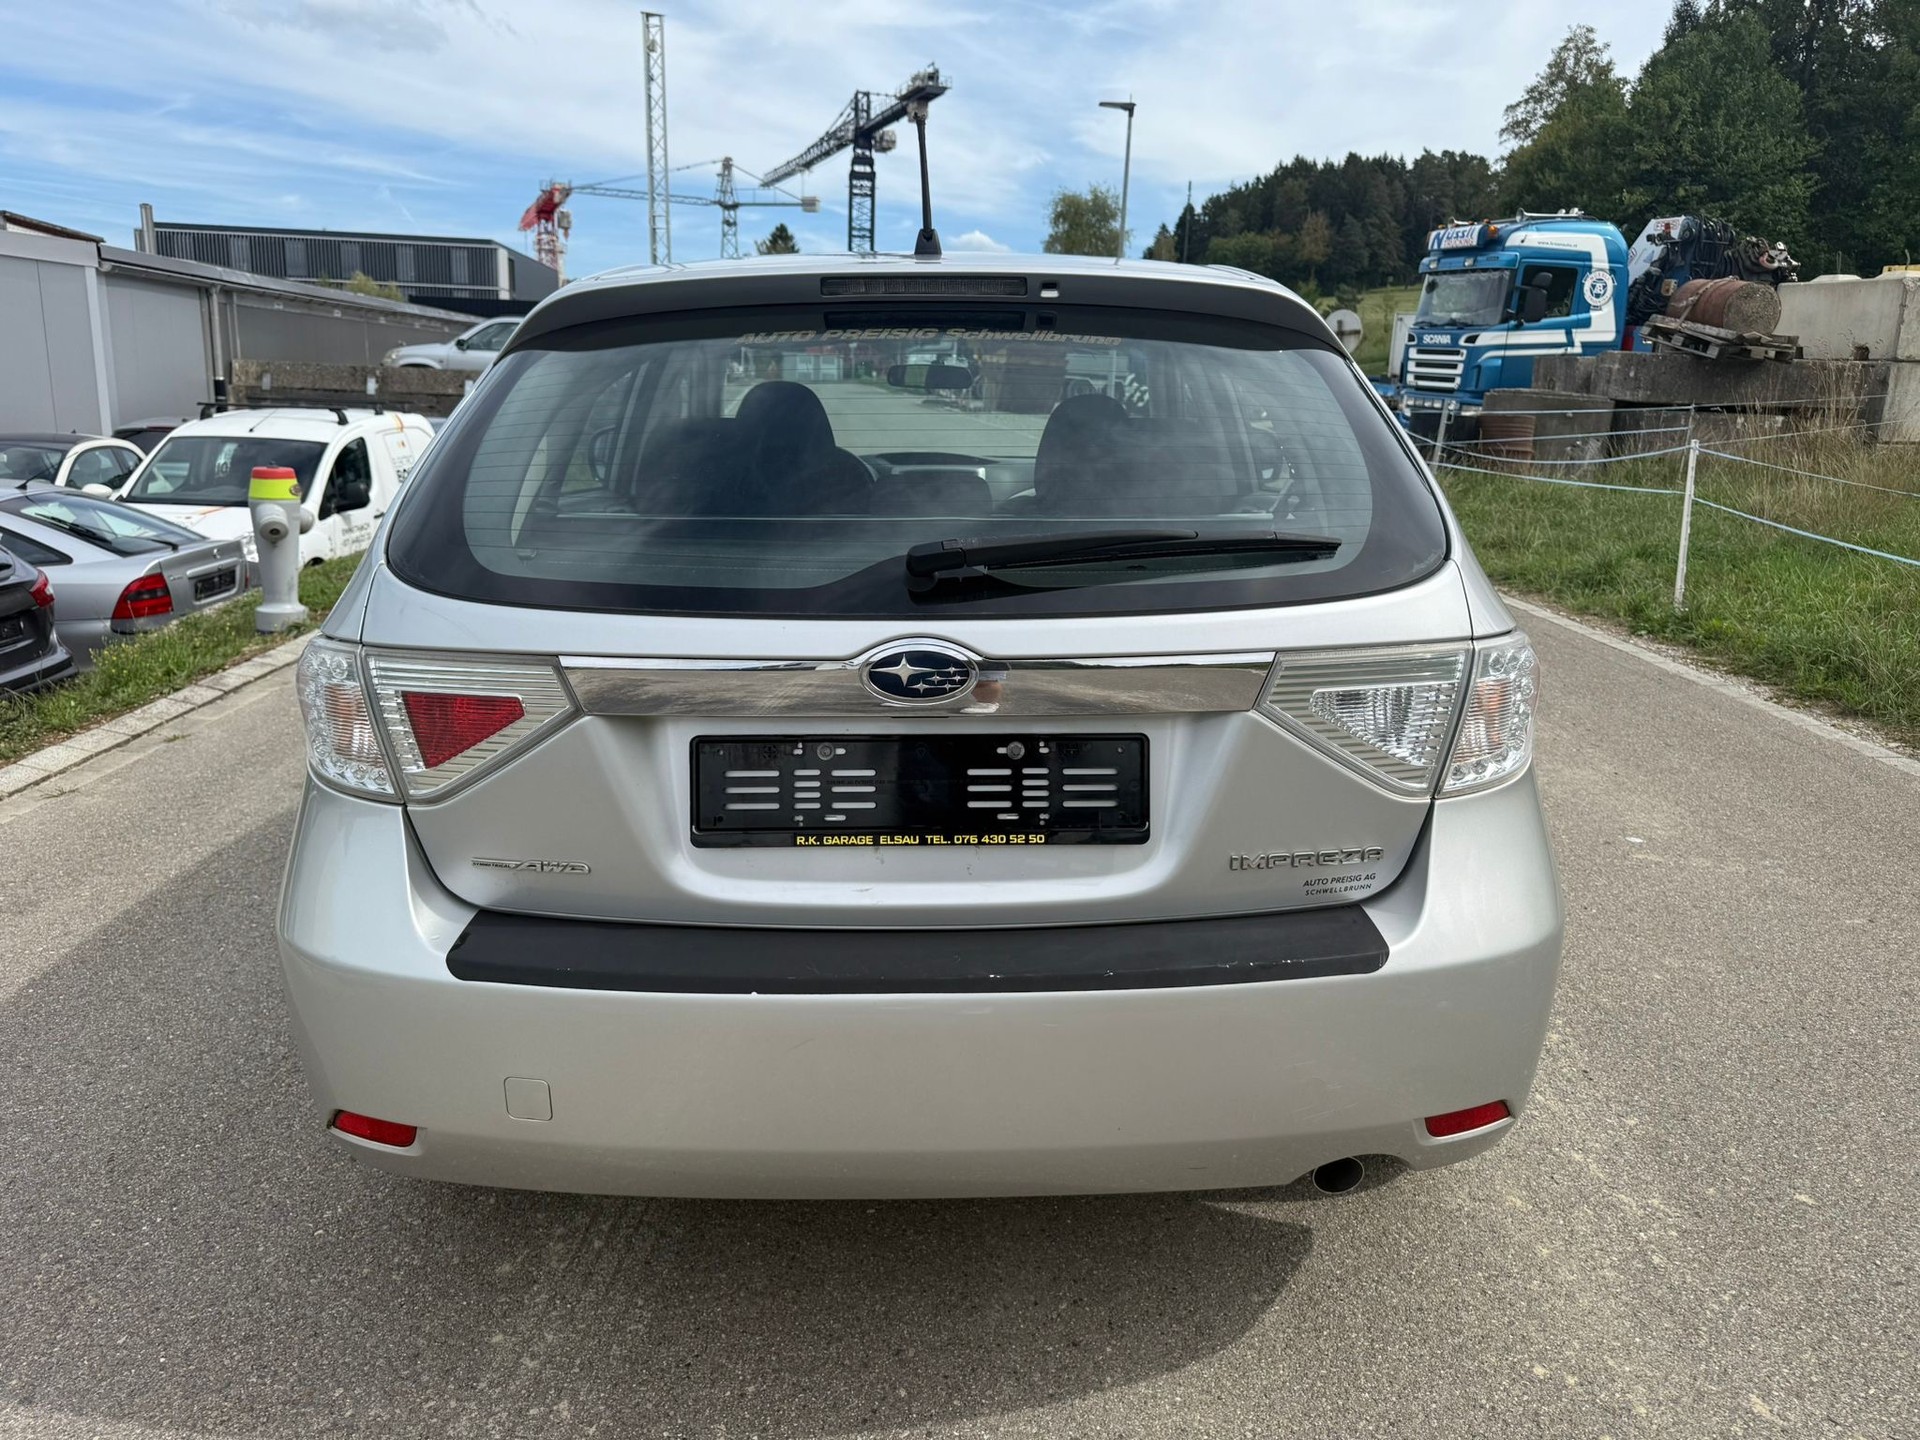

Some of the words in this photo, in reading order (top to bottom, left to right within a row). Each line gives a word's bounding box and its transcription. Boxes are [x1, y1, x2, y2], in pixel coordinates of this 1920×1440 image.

[735, 330, 817, 344] AUTO
[821, 328, 939, 341] PREISIG
[944, 328, 1122, 346] Schwellbrunn
[1422, 334, 1451, 345] SCANIA
[796, 836, 820, 845] R.K.
[823, 836, 873, 845] GARAGE
[880, 835, 919, 845] ELSAU
[925, 835, 951, 845] TEL.
[954, 835, 979, 845] 076
[981, 834, 1006, 844] 430
[1009, 834, 1025, 844] 52
[1028, 834, 1045, 844] 50
[1229, 846, 1385, 871] IMPREZA
[513, 859, 591, 875] AWD
[1303, 877, 1329, 888] AUTO
[1330, 874, 1363, 885] PREISIG
[1363, 872, 1377, 882] AG
[1305, 883, 1373, 896] SCHWELLBRUNN
